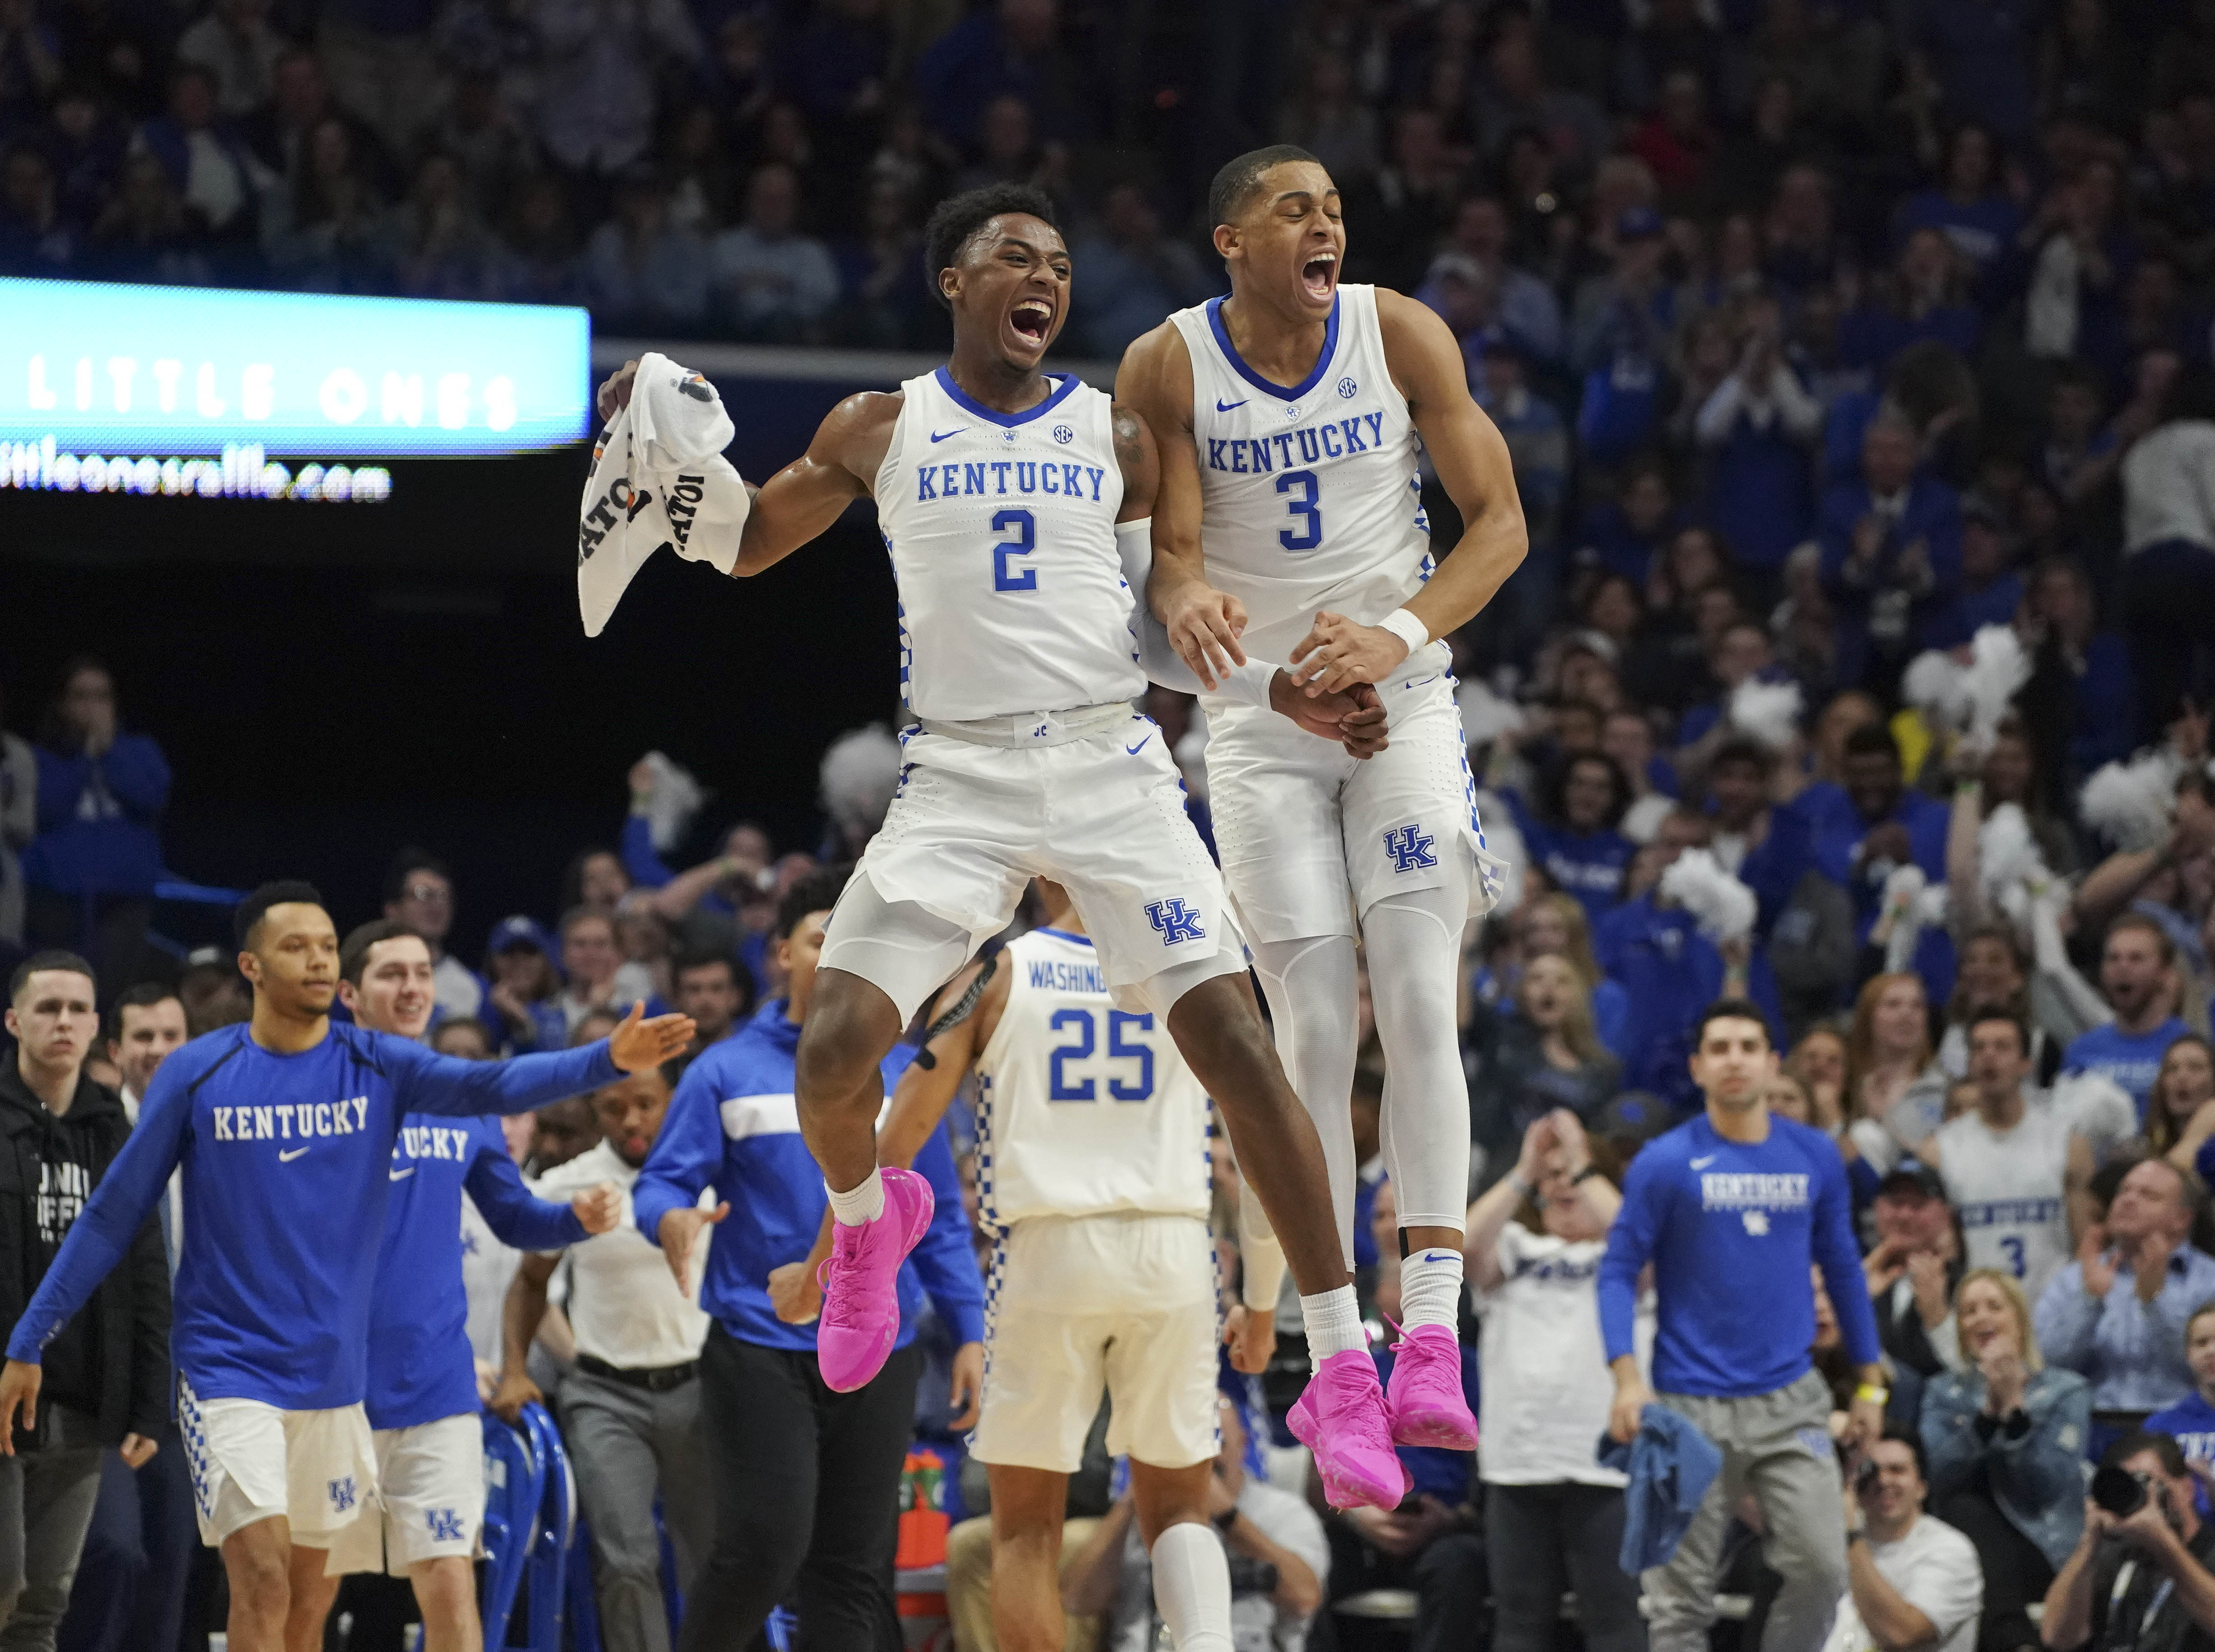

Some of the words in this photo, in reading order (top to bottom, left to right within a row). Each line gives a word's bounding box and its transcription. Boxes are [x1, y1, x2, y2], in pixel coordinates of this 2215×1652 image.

[29, 353, 276, 420] LITTLE
[318, 367, 518, 432] ONES
[1338, 377, 1356, 398] SEC
[1054, 425, 1073, 443] SEC
[1208, 411, 1383, 473] KENTUCKY
[918, 461, 1104, 501] KENTUCKY
[1275, 469, 1323, 551] 3
[991, 509, 1038, 592] 2
[1383, 823, 1437, 874] UK
[1144, 898, 1206, 946] UK
[1049, 1009, 1154, 1101] 25
[213, 1095, 369, 1141] KENTUCKY
[424, 1508, 465, 1542] UK
